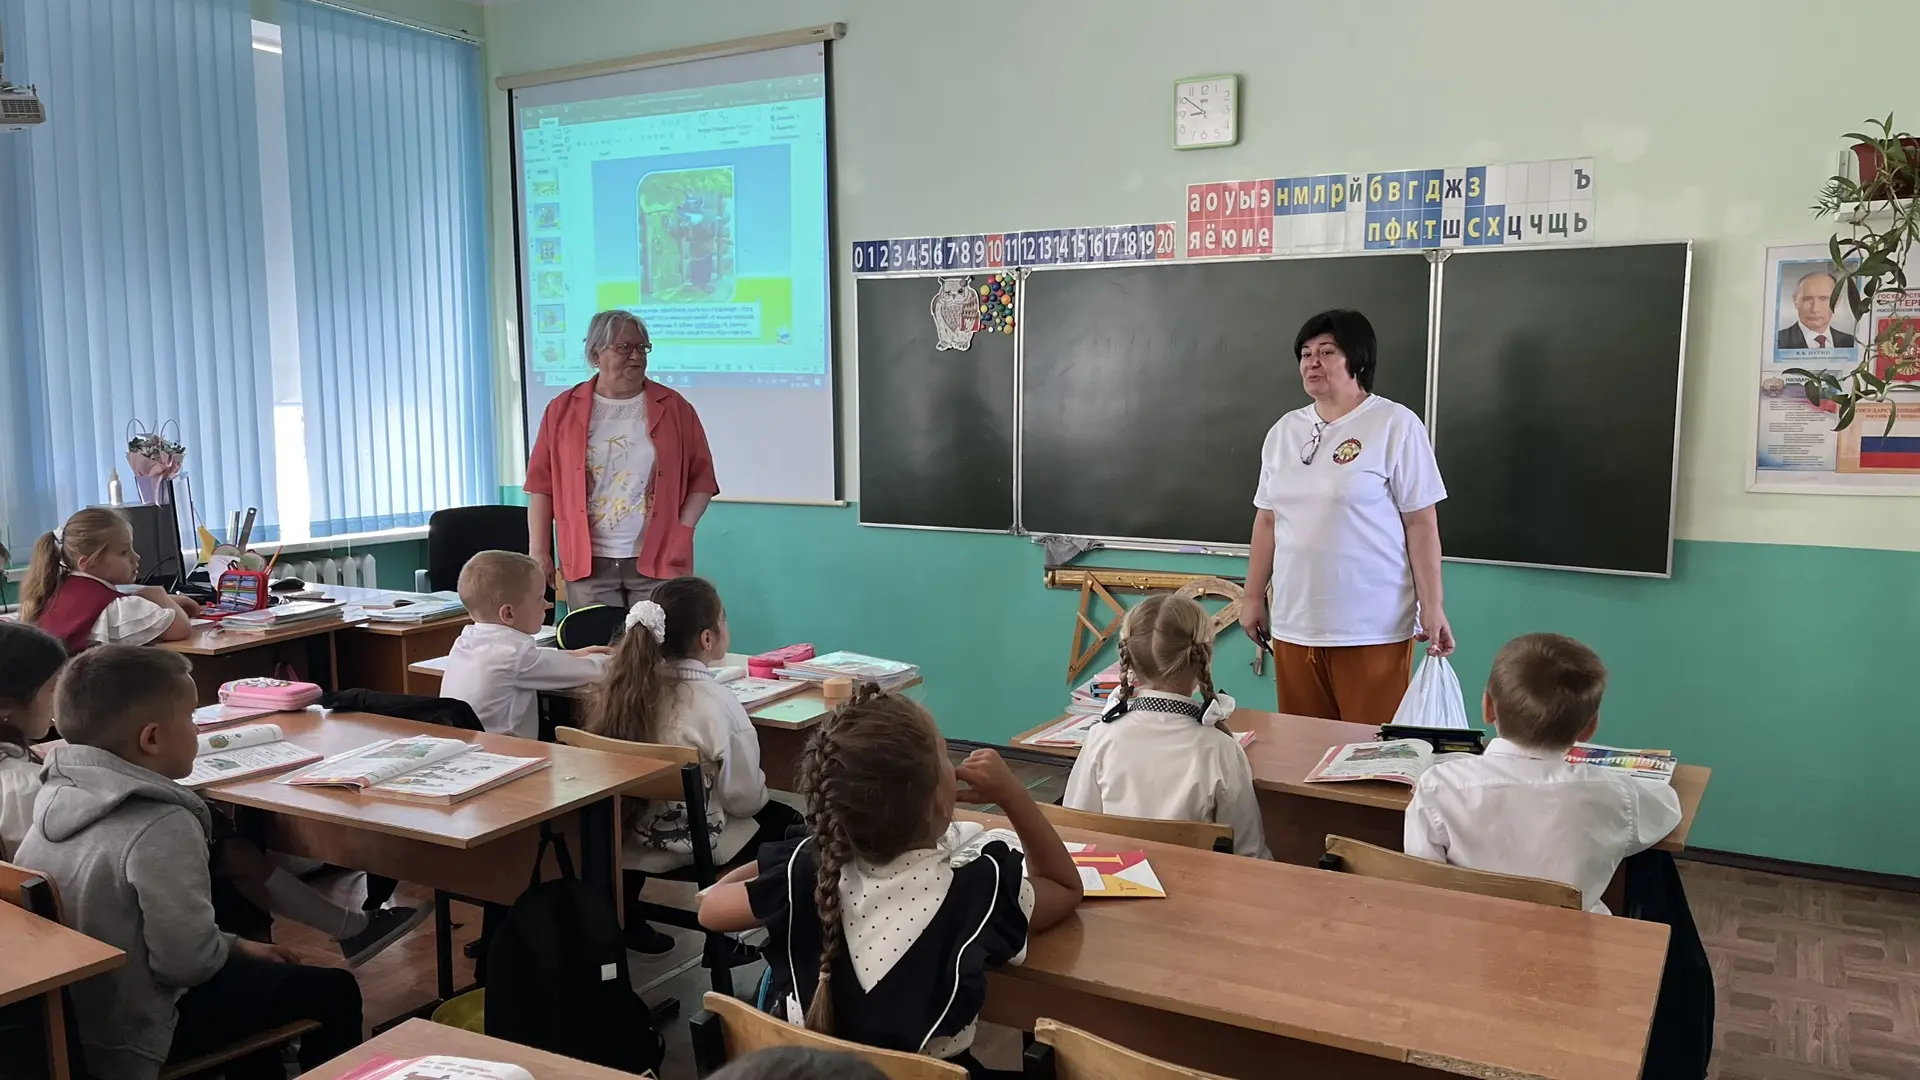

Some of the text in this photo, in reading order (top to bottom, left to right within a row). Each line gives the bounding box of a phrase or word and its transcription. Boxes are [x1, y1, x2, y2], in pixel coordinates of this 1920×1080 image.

[854, 230, 1172, 268] 0 1 2 3 4 5 6 7 8 9 10 11 12 13 14 15 16 17 18 19 20
